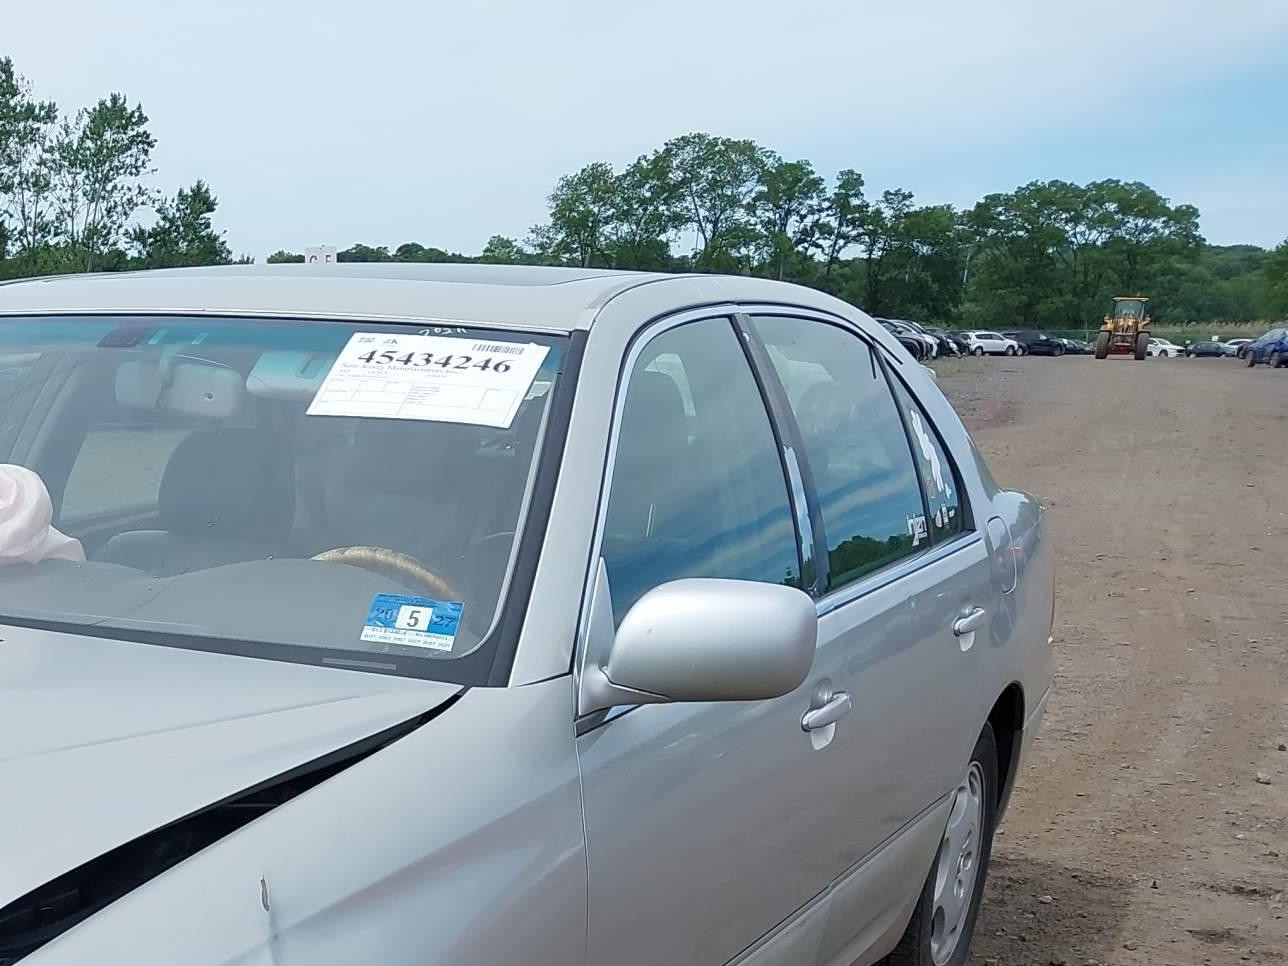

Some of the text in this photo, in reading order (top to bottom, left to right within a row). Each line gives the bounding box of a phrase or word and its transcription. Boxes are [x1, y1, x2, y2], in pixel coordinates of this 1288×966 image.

[358, 349, 514, 373] 45434246
[376, 608, 456, 628] 20 5 27
